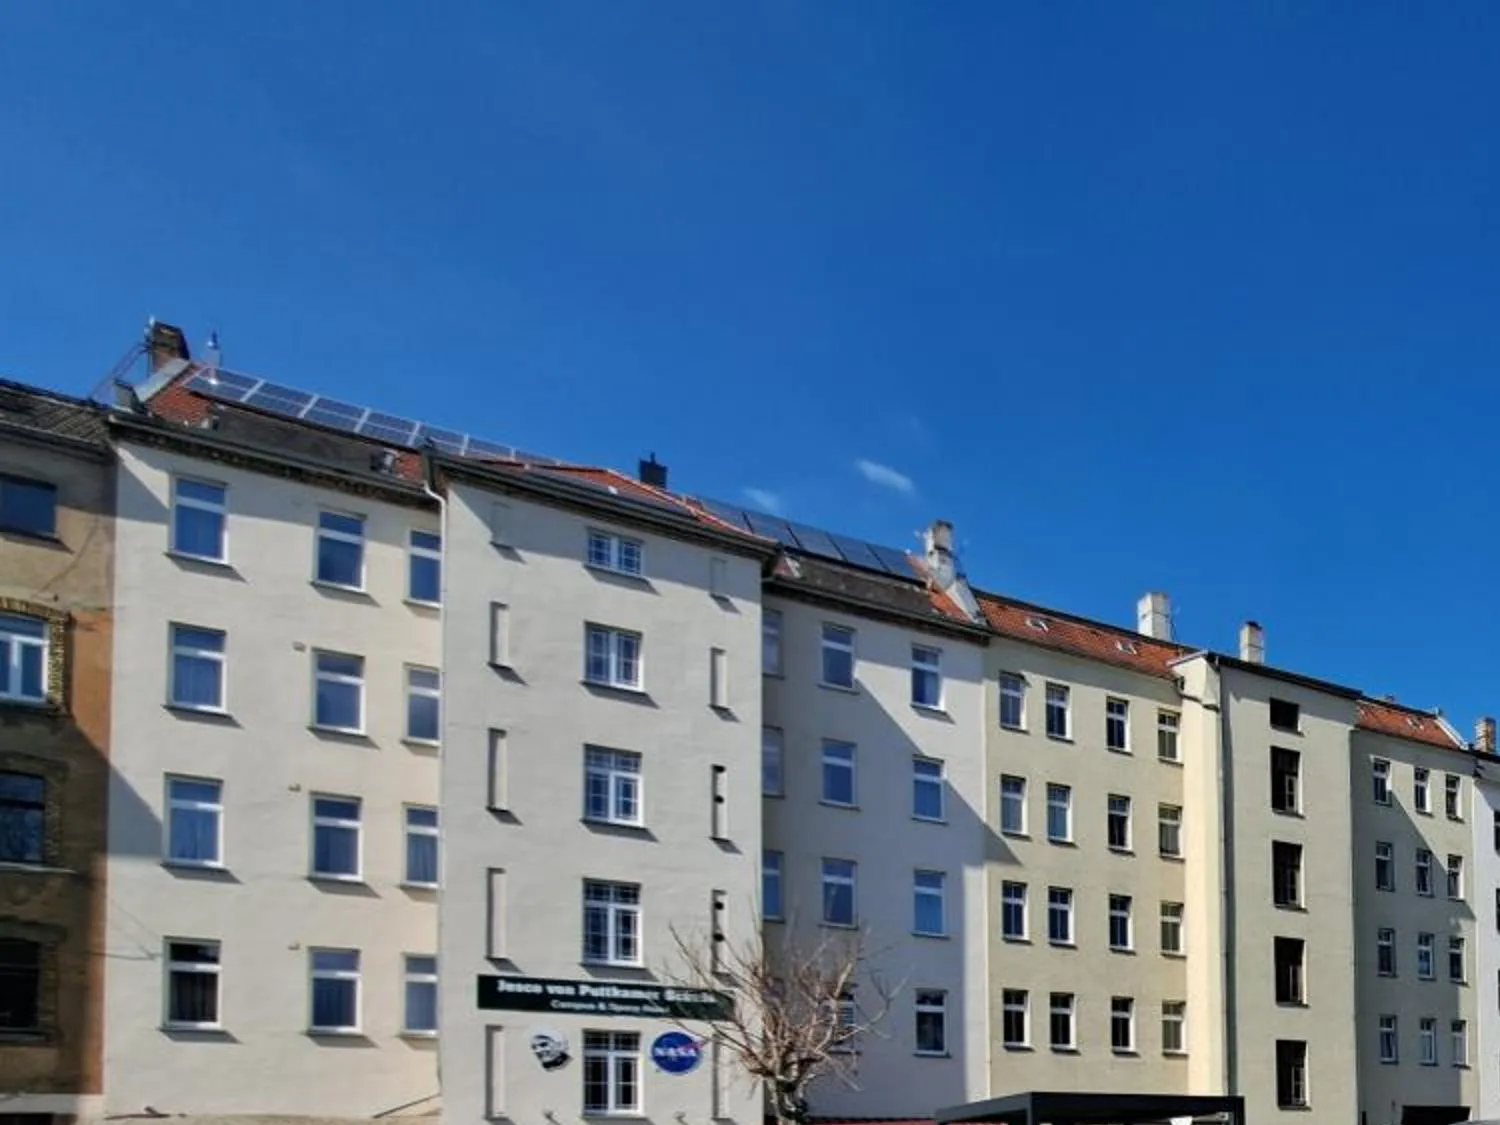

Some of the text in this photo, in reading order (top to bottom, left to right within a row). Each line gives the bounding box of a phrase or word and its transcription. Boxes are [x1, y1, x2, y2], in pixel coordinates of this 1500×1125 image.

[545, 985, 576, 995] von
[578, 985, 660, 1000] Puttkamer
[597, 1001, 607, 1011] &
[655, 1047, 697, 1057] NASA
